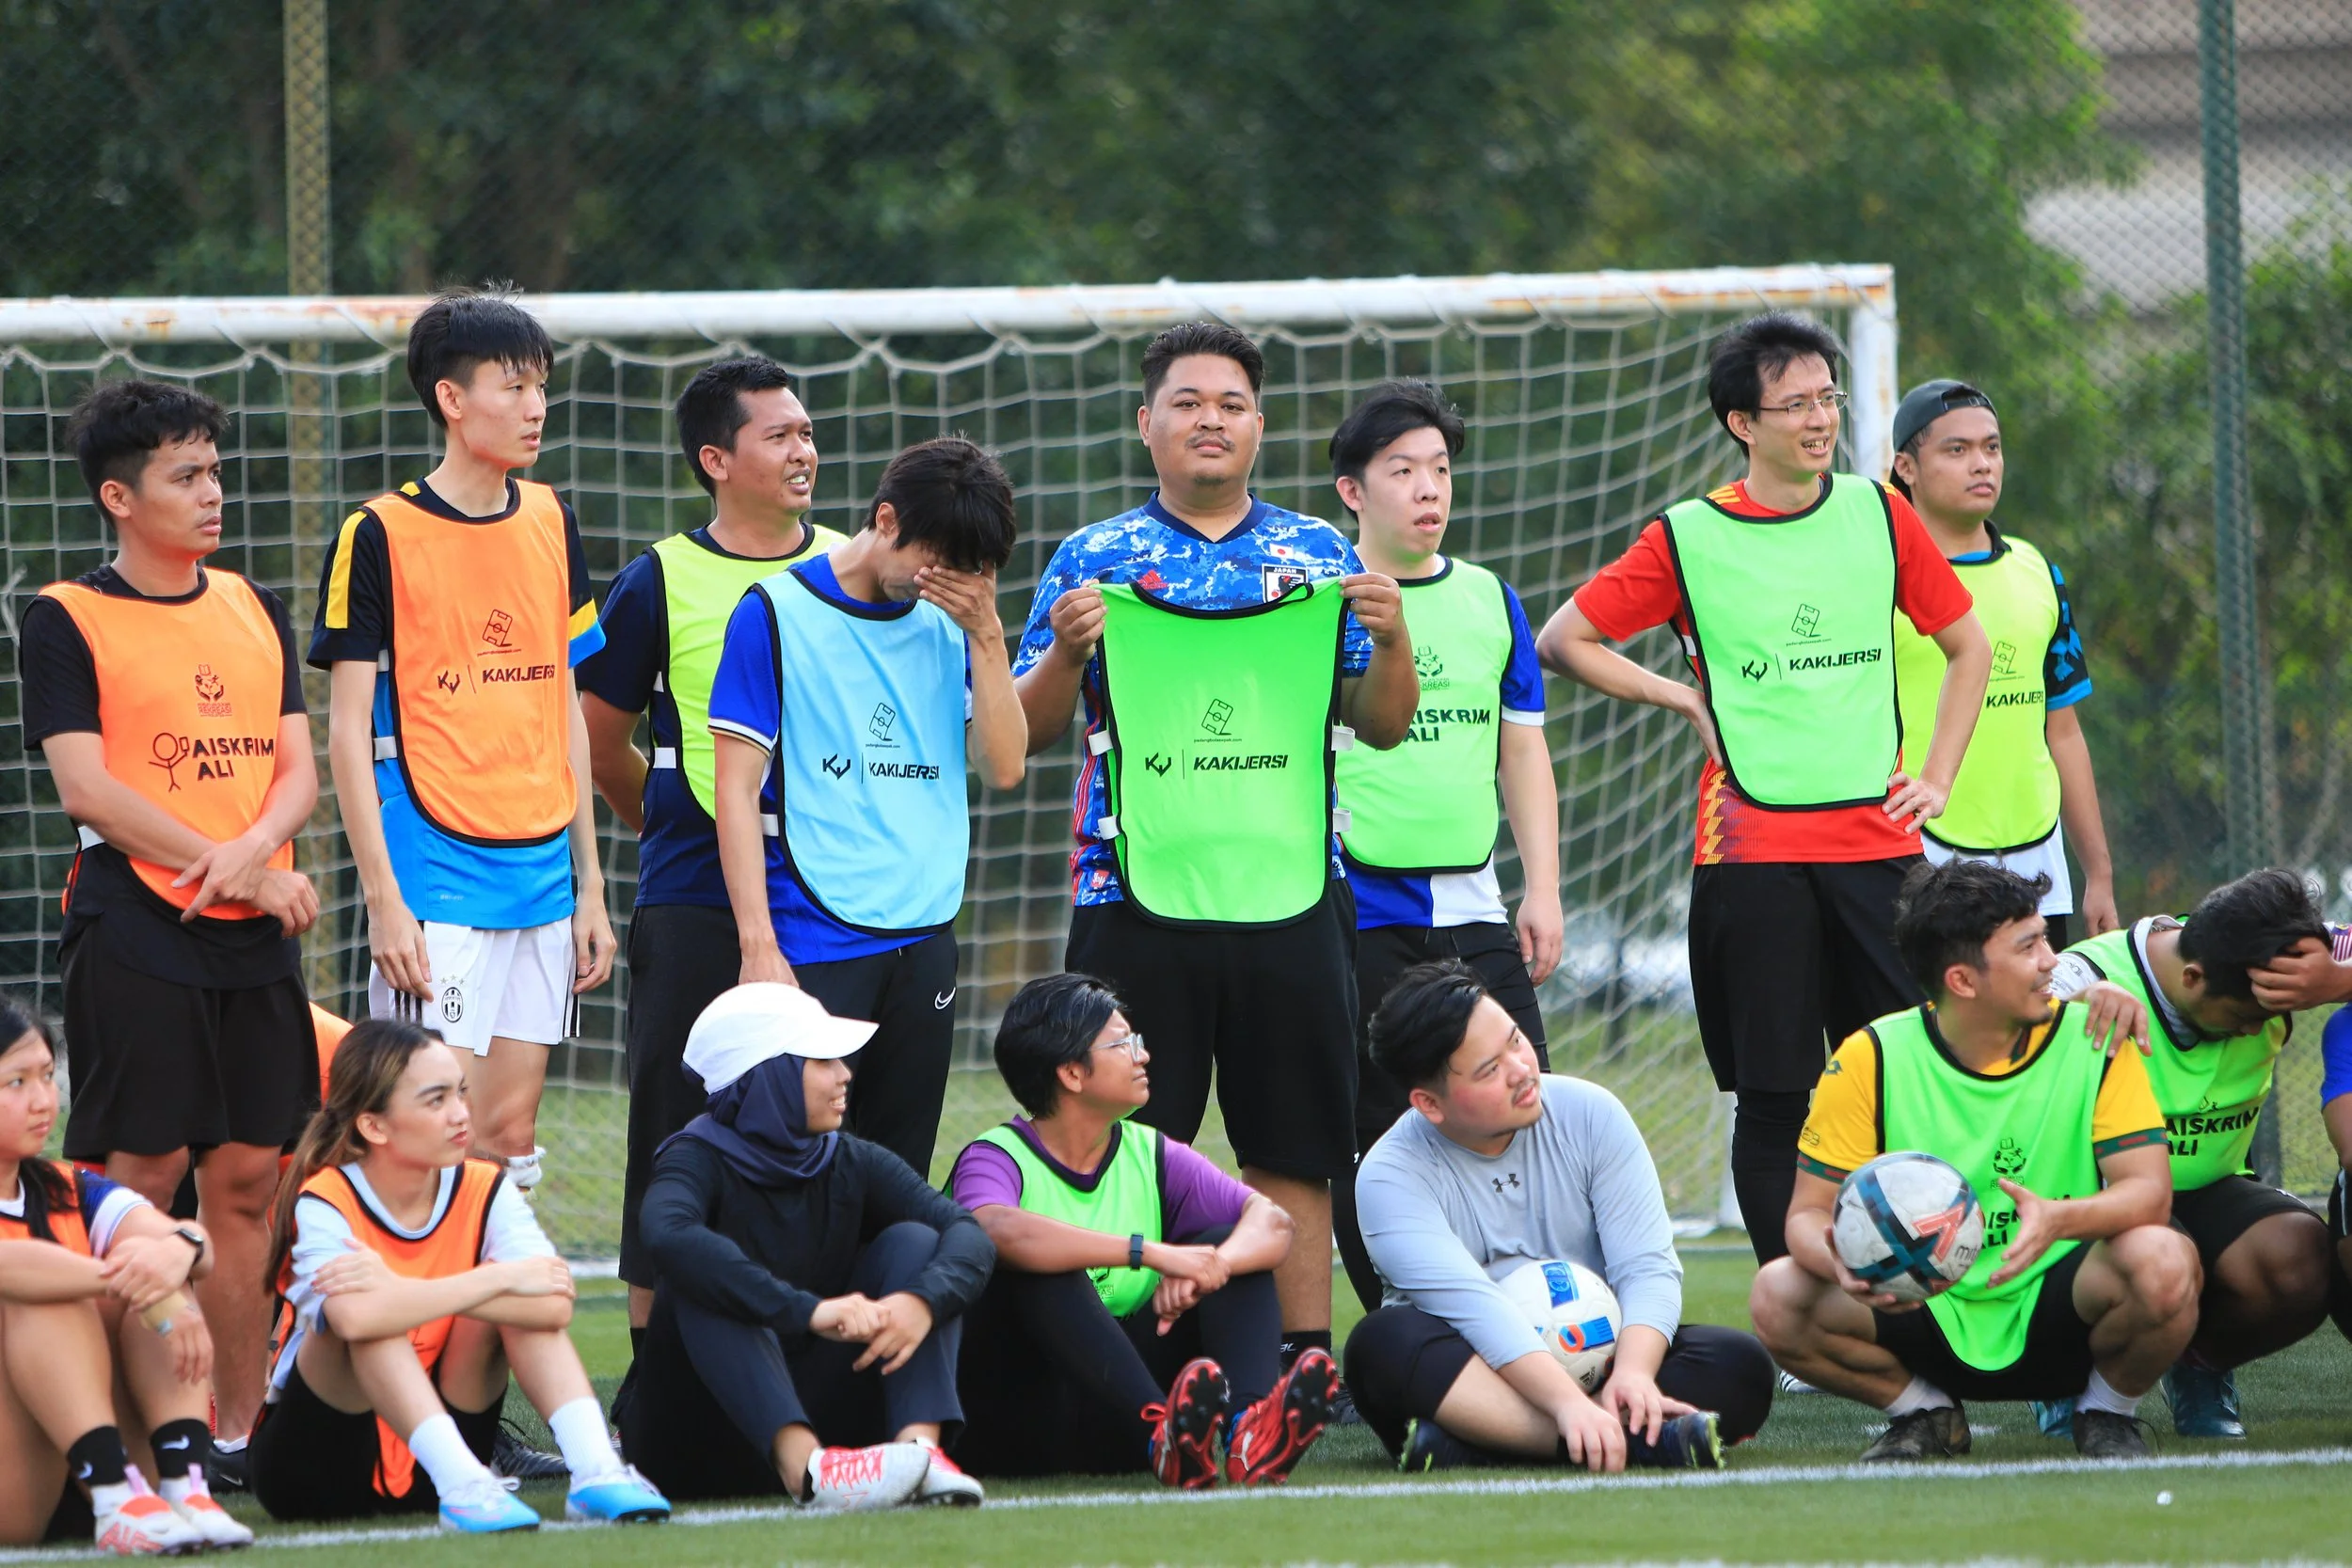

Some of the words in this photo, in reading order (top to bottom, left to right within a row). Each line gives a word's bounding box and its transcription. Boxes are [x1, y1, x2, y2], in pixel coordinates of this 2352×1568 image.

[1789, 648, 1882, 671] KAKIJERSI
[193, 737, 275, 758] AISKRIM
[197, 759, 234, 782] ALI
[868, 762, 940, 780] KAKIJERSI
[1193, 754, 1289, 770] KAKIJERSI
